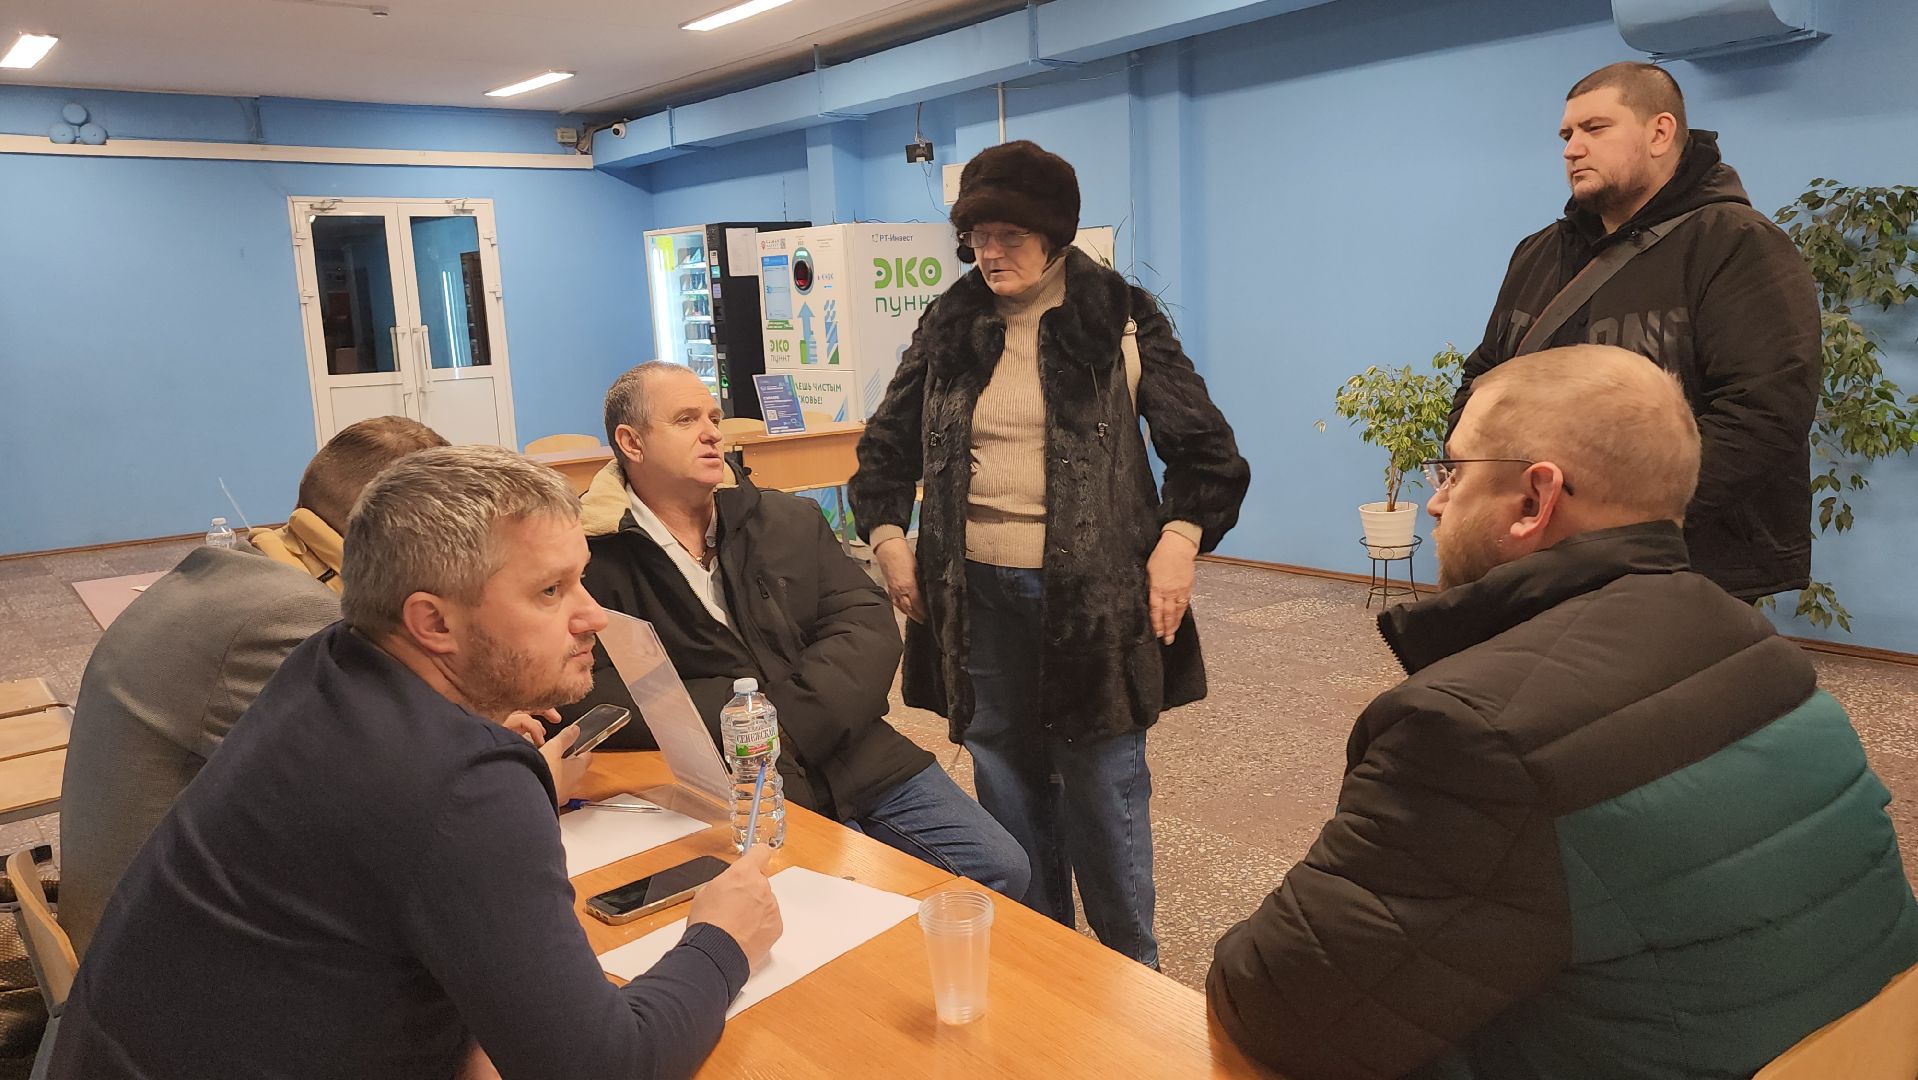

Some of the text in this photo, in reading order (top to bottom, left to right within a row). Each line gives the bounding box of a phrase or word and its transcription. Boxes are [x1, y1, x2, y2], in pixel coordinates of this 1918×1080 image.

[873, 257, 942, 289] ЭКО
[769, 339, 790, 353] ЭКО
[813, 382, 842, 392] ЧИСТЫМ
[798, 395, 823, 405] КОВЬЕ!
